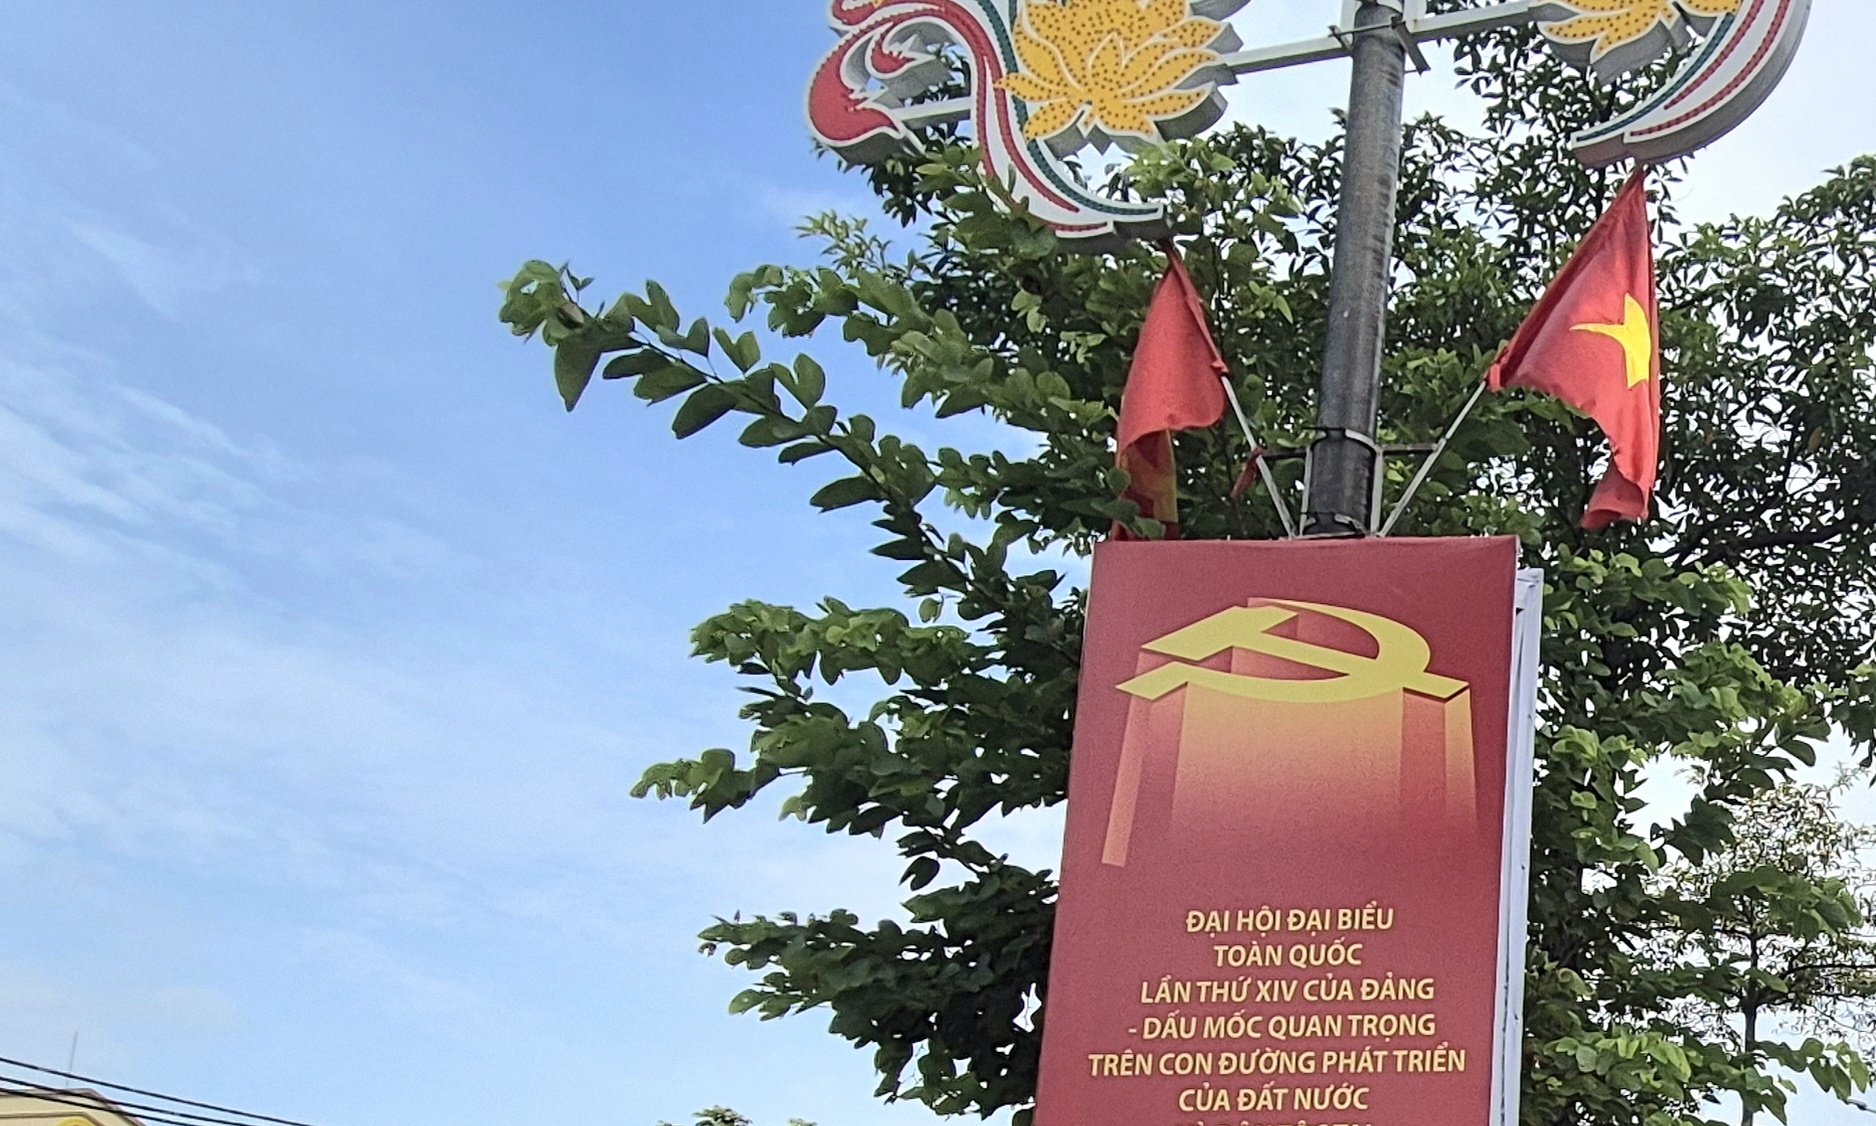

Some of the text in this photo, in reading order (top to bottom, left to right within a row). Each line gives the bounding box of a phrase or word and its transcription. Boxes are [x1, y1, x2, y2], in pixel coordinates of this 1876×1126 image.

[1185, 900, 1394, 938] ĐẠI HỘI ĐẠI BIỂU
[1213, 936, 1363, 969] TOÀN QUỐC
[1141, 971, 1435, 1004] LẦN THỨ XIV CỦA ĐẢNG
[1142, 1009, 1197, 1040] DẤU
[1202, 1009, 1263, 1039] MỐC
[1268, 1015, 1342, 1041] QUAN
[1347, 1013, 1436, 1043] TRỌNG
[1088, 1041, 1466, 1077] TRÊN CON ĐƯỜNG PHÁT TRIỂN
[1178, 1080, 1370, 1112] CỦA ĐẤT NƯỚC
